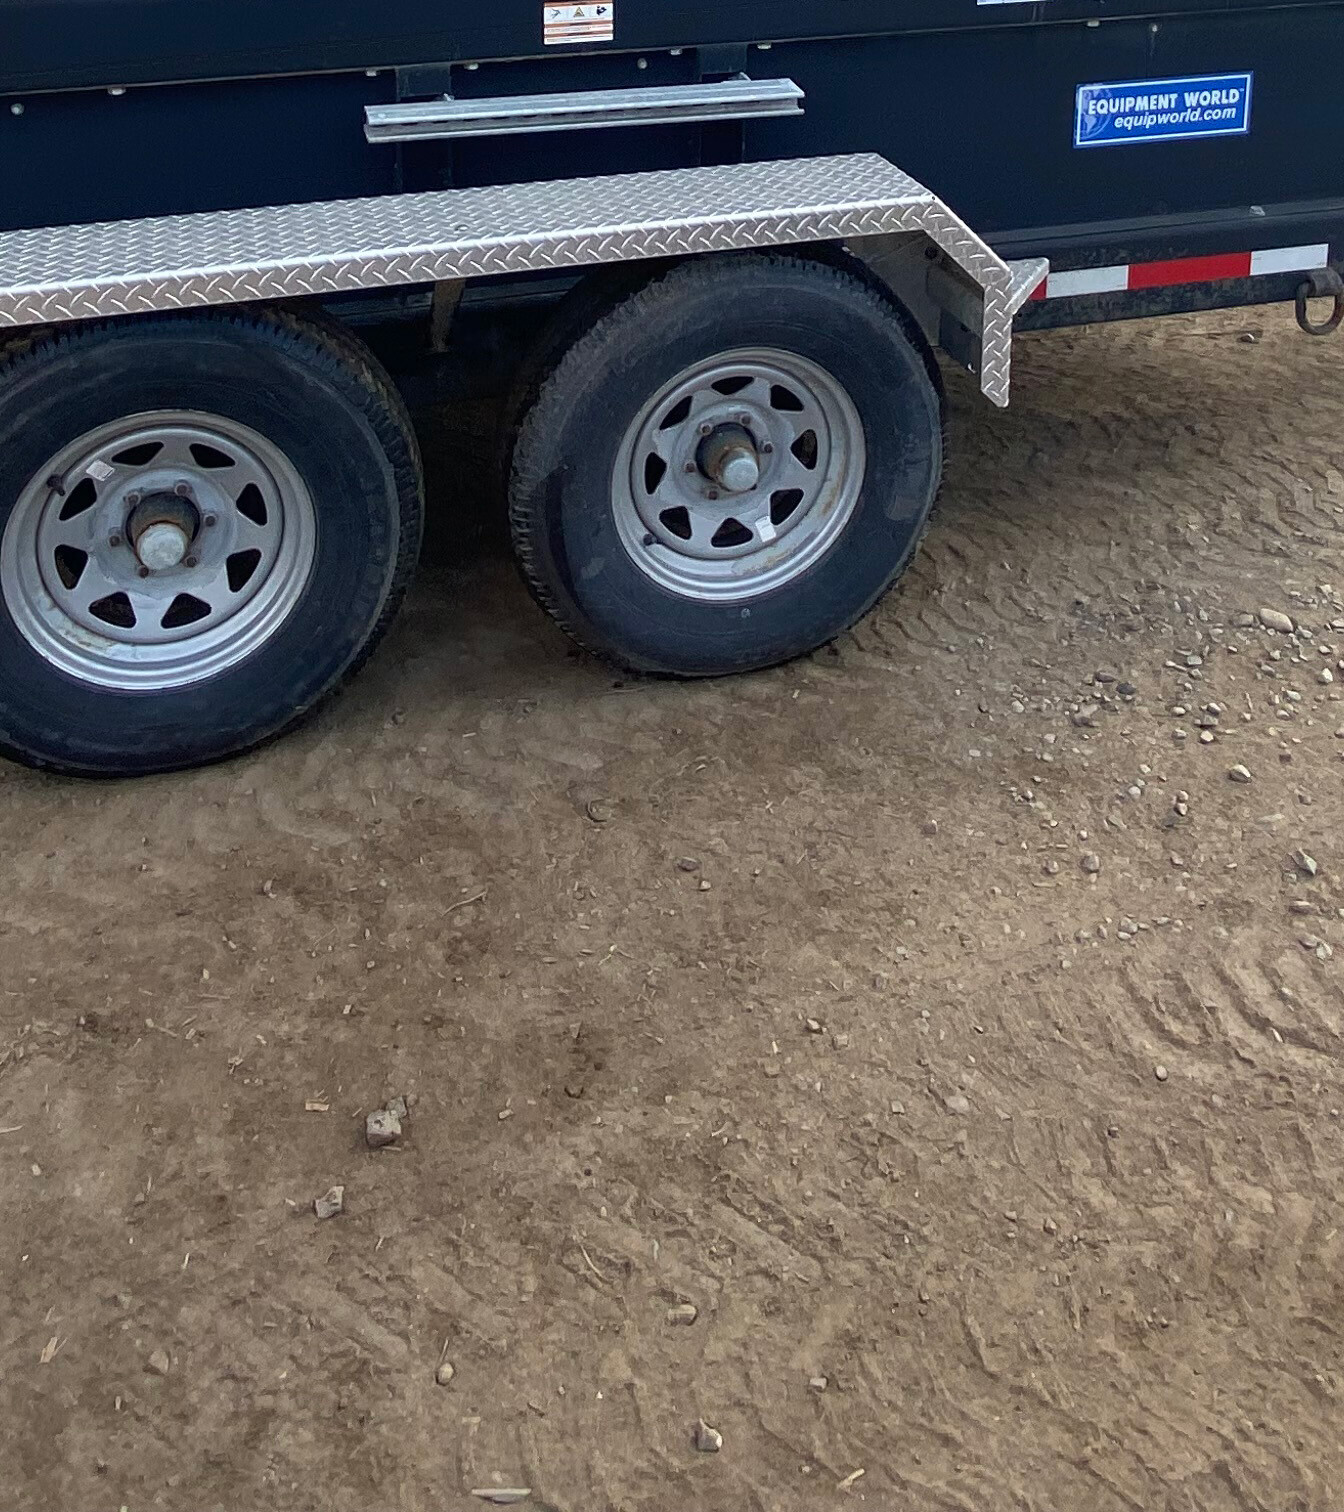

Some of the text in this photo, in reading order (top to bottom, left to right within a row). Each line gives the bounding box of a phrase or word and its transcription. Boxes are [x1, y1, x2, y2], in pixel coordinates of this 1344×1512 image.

[1088, 88, 1240, 116] EQUIPMENT WORLD
[1113, 106, 1237, 130] equipworld.com
